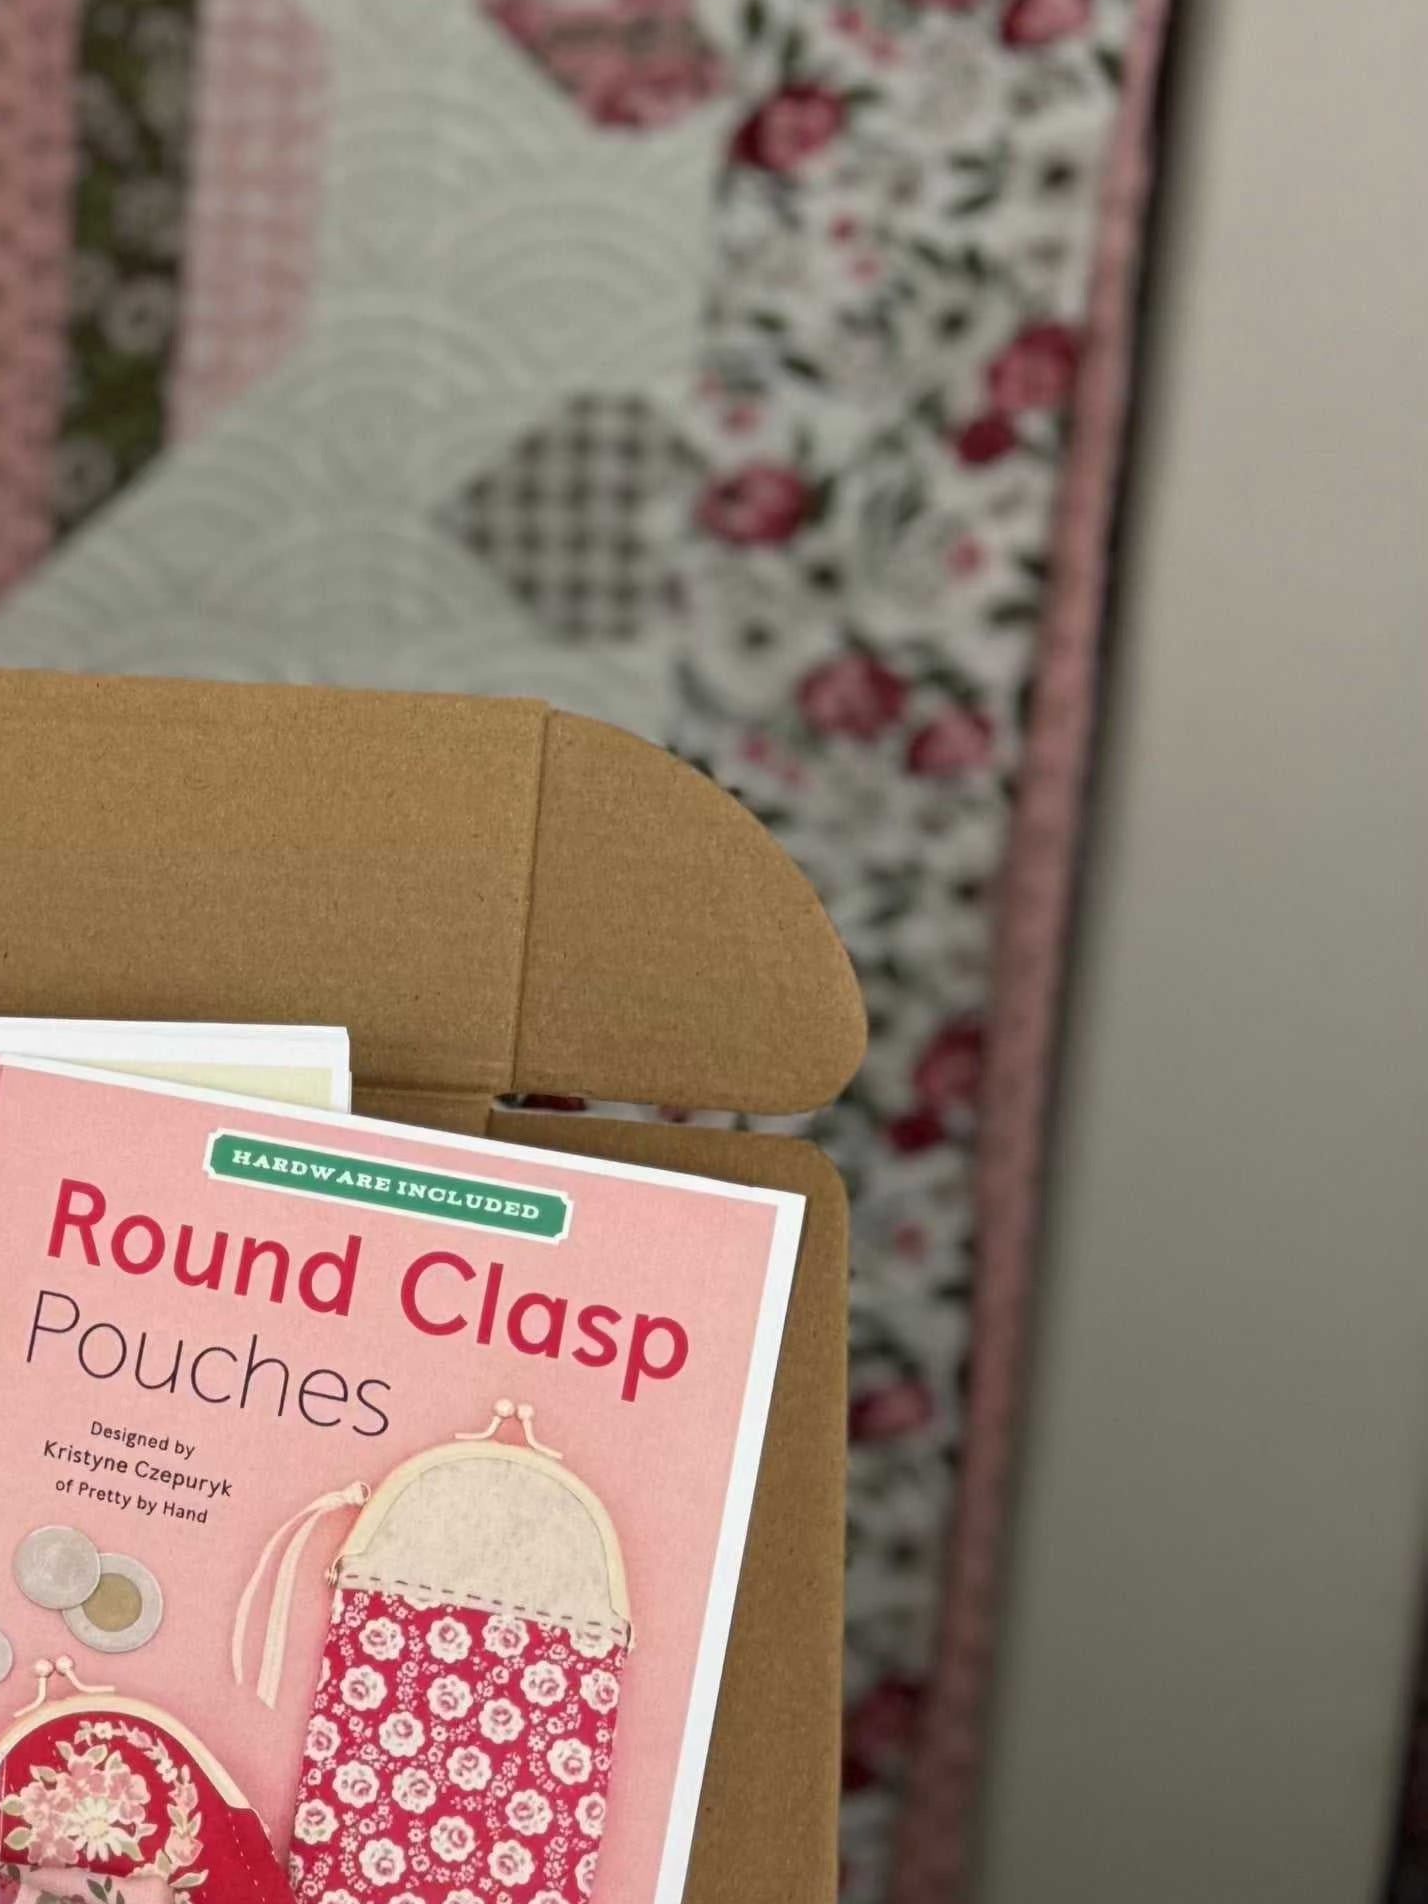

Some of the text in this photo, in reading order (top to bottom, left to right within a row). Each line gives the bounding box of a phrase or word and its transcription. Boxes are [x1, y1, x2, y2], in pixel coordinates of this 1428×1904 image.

[231, 1148, 540, 1222] HARDWARE INCLUDED
[47, 1177, 691, 1402] Round Clasp
[26, 1289, 392, 1437] Pouches
[43, 1440, 233, 1498] Kristyne Czepuryk
[89, 1420, 195, 1460] Designed by
[55, 1476, 208, 1525] of Pretty by Hand
